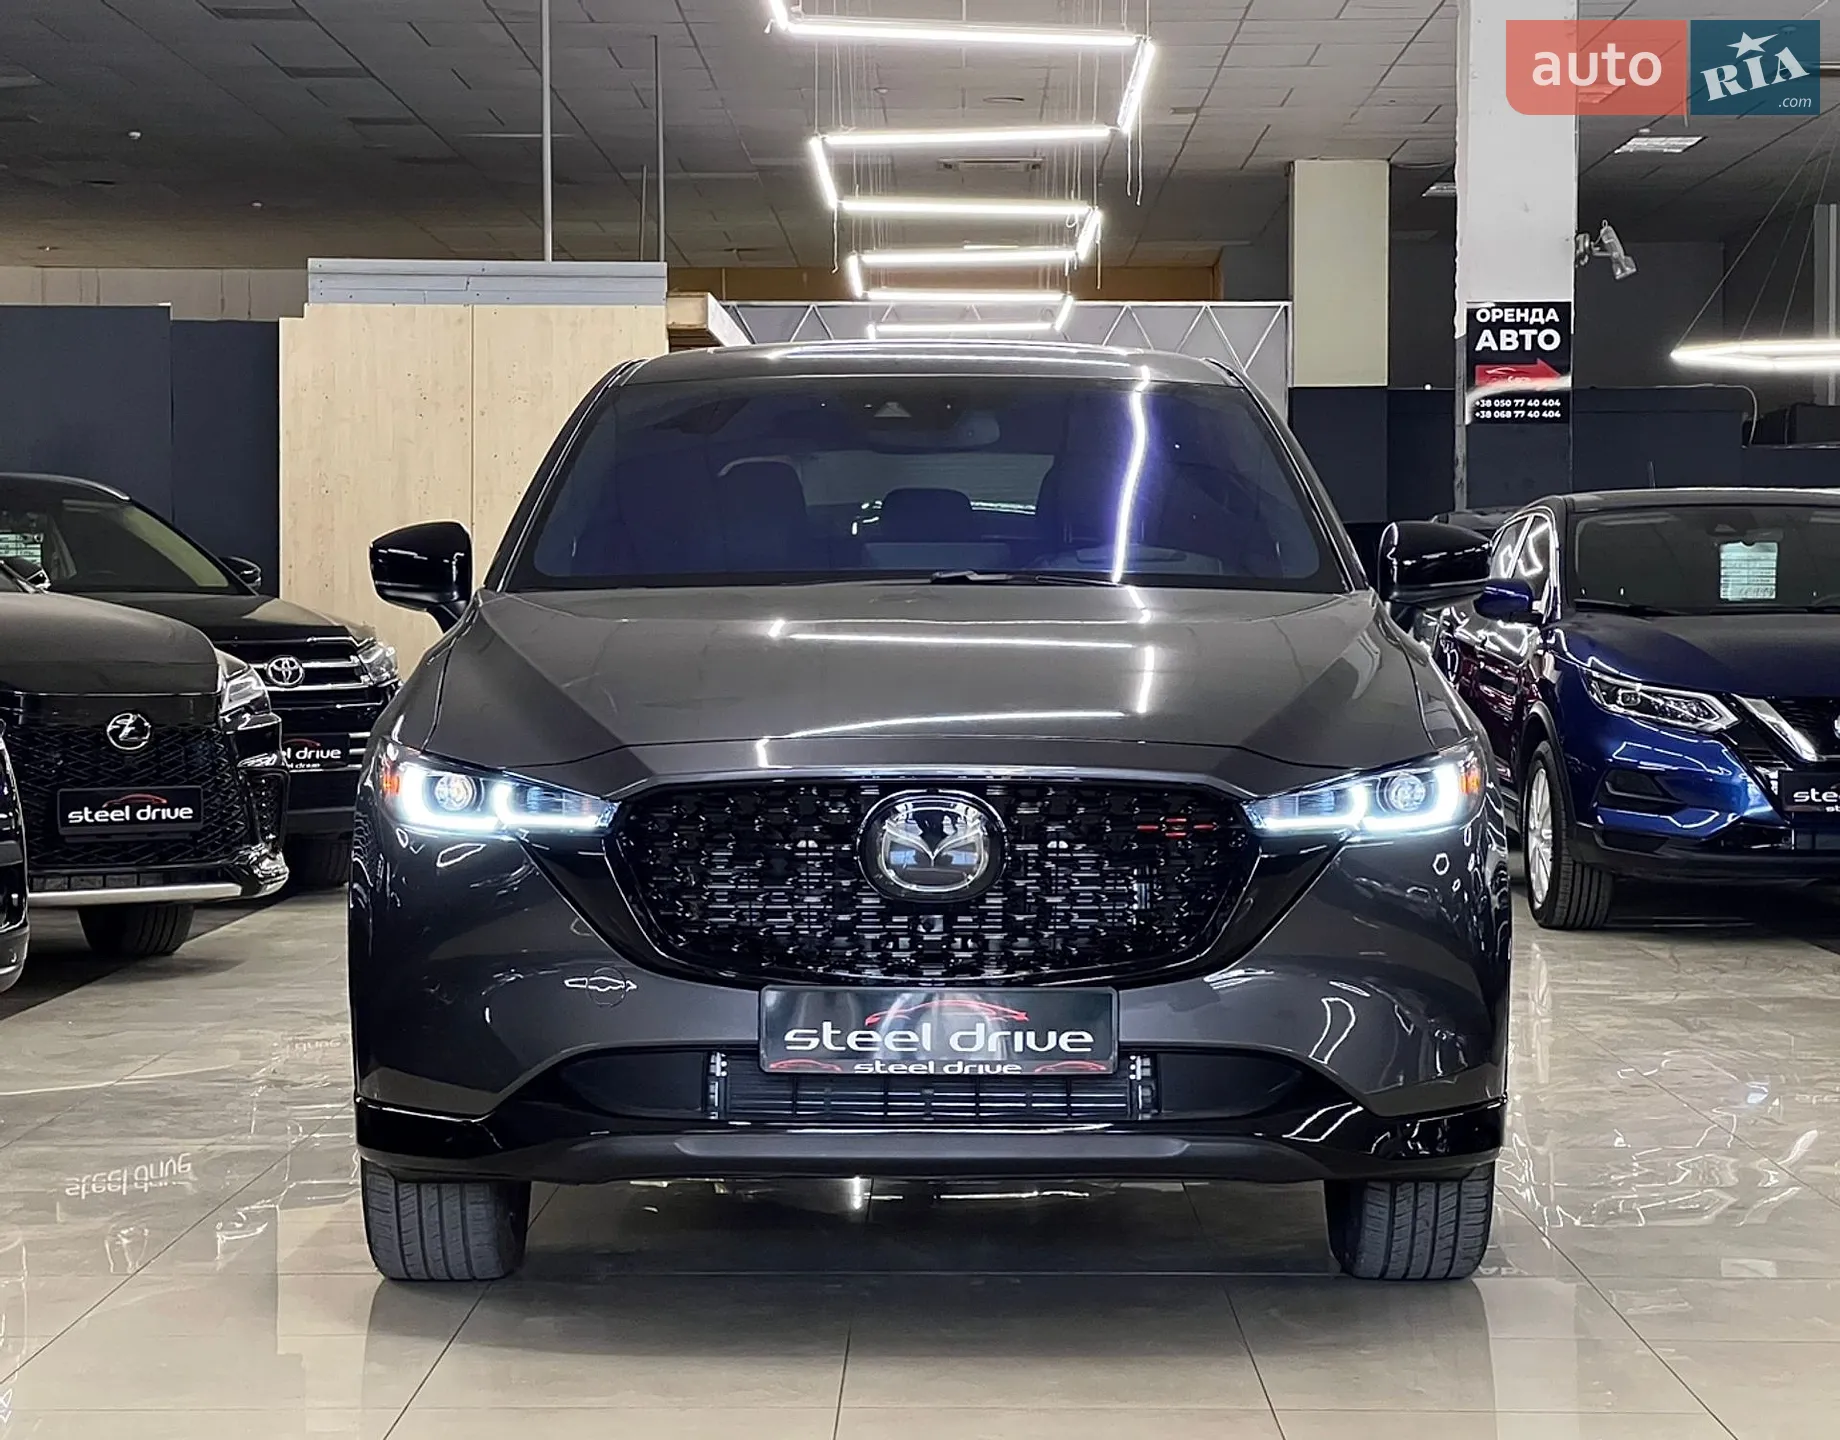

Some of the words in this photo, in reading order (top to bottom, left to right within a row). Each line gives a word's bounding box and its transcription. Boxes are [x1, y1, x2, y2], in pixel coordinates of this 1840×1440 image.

[1476, 308, 1560, 325] ОРЕНДА
[1475, 328, 1561, 351] АВТО
[1475, 399, 1492, 408] +38
[1513, 399, 1525, 408] 77
[1527, 399, 1540, 408] 40
[1541, 399, 1561, 408] 404
[1475, 410, 1492, 419] +38
[1513, 410, 1525, 419] 77
[1527, 410, 1540, 419] 40
[1541, 410, 1561, 419] 404
[295, 747, 342, 760] drive
[1793, 788, 1840, 803] ste
[67, 805, 130, 823] steel
[136, 805, 193, 821] drive
[784, 1021, 932, 1052] steel
[949, 1022, 1095, 1053] drive
[854, 1060, 935, 1074] steel
[943, 1061, 1022, 1074] drive
